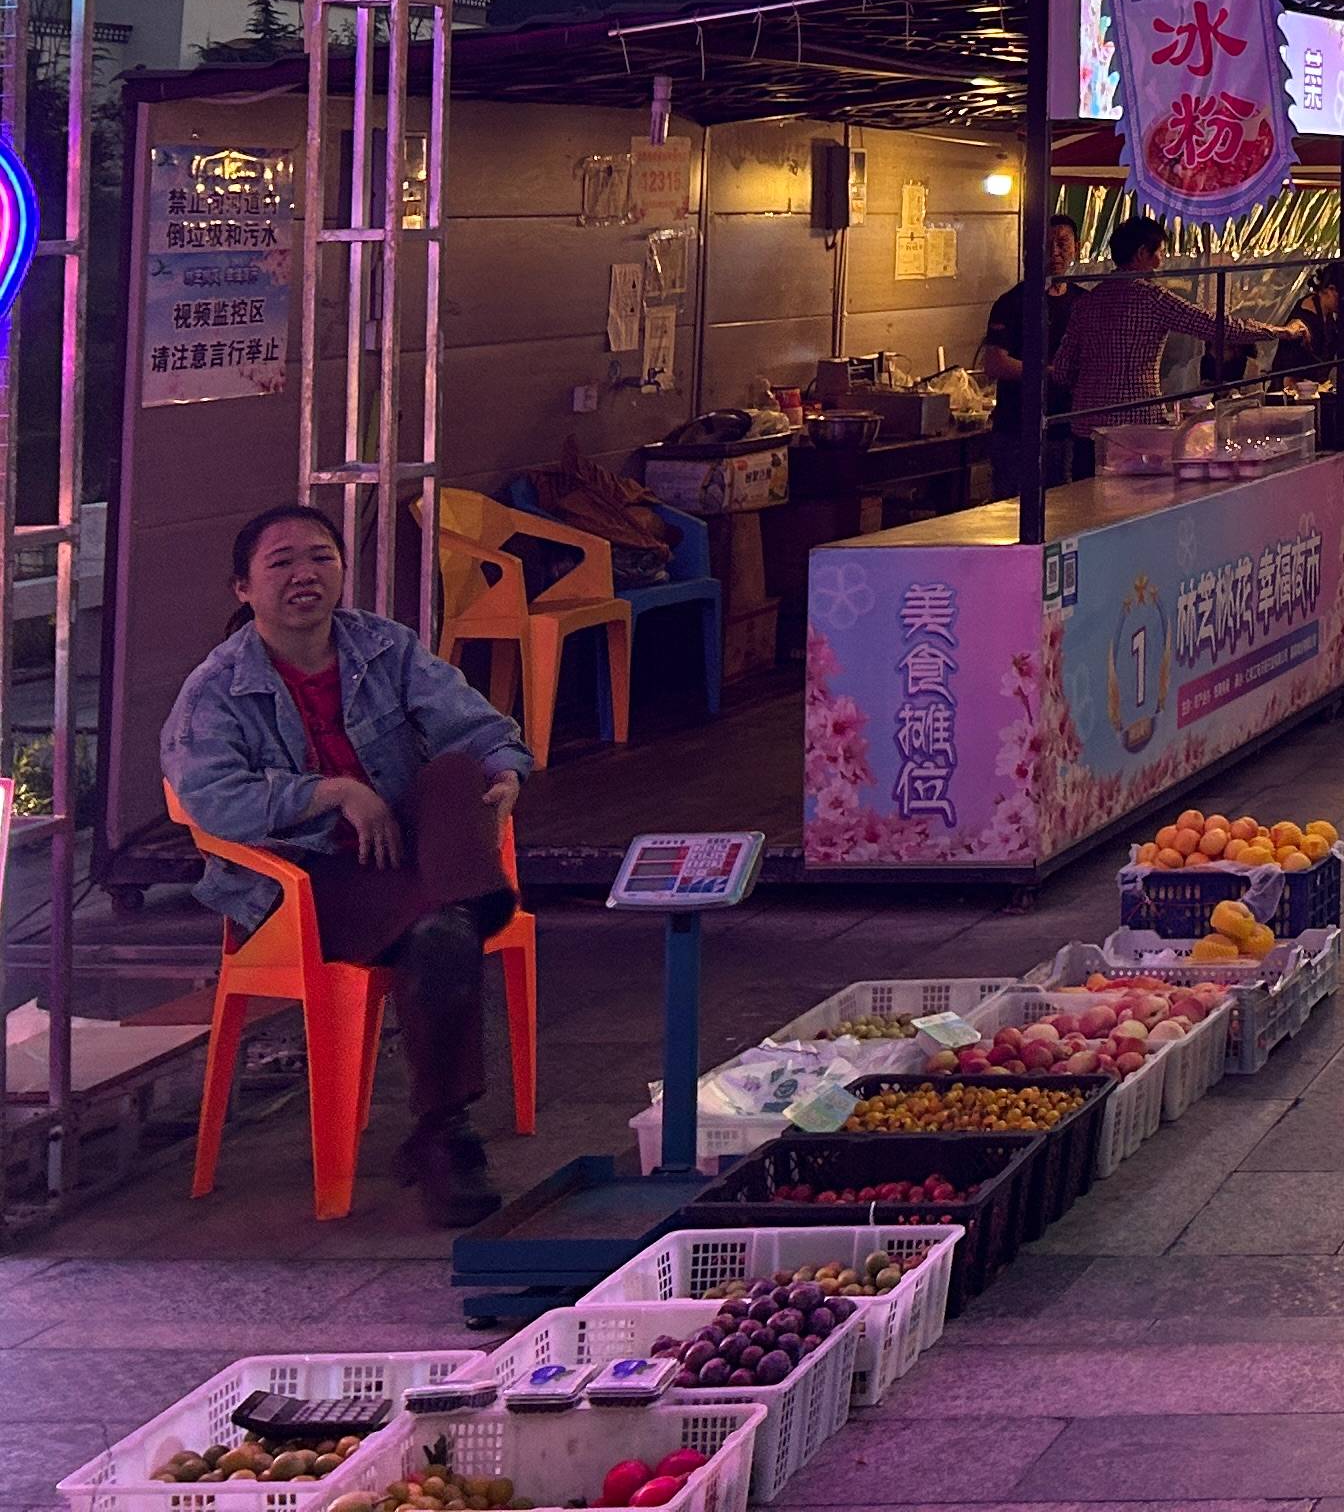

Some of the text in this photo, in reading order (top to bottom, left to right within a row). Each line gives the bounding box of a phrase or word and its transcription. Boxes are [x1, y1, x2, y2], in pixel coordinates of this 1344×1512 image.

[1151, 0, 1256, 167] 冰粉
[166, 221, 278, 249] 倒垃圾和污水
[173, 299, 266, 330] 视频监控区
[151, 337, 280, 373] 请注意言行举止
[1176, 556, 1255, 664] 林芝桃花
[1256, 531, 1323, 634] 幸福夜市
[1130, 625, 1147, 708] 1
